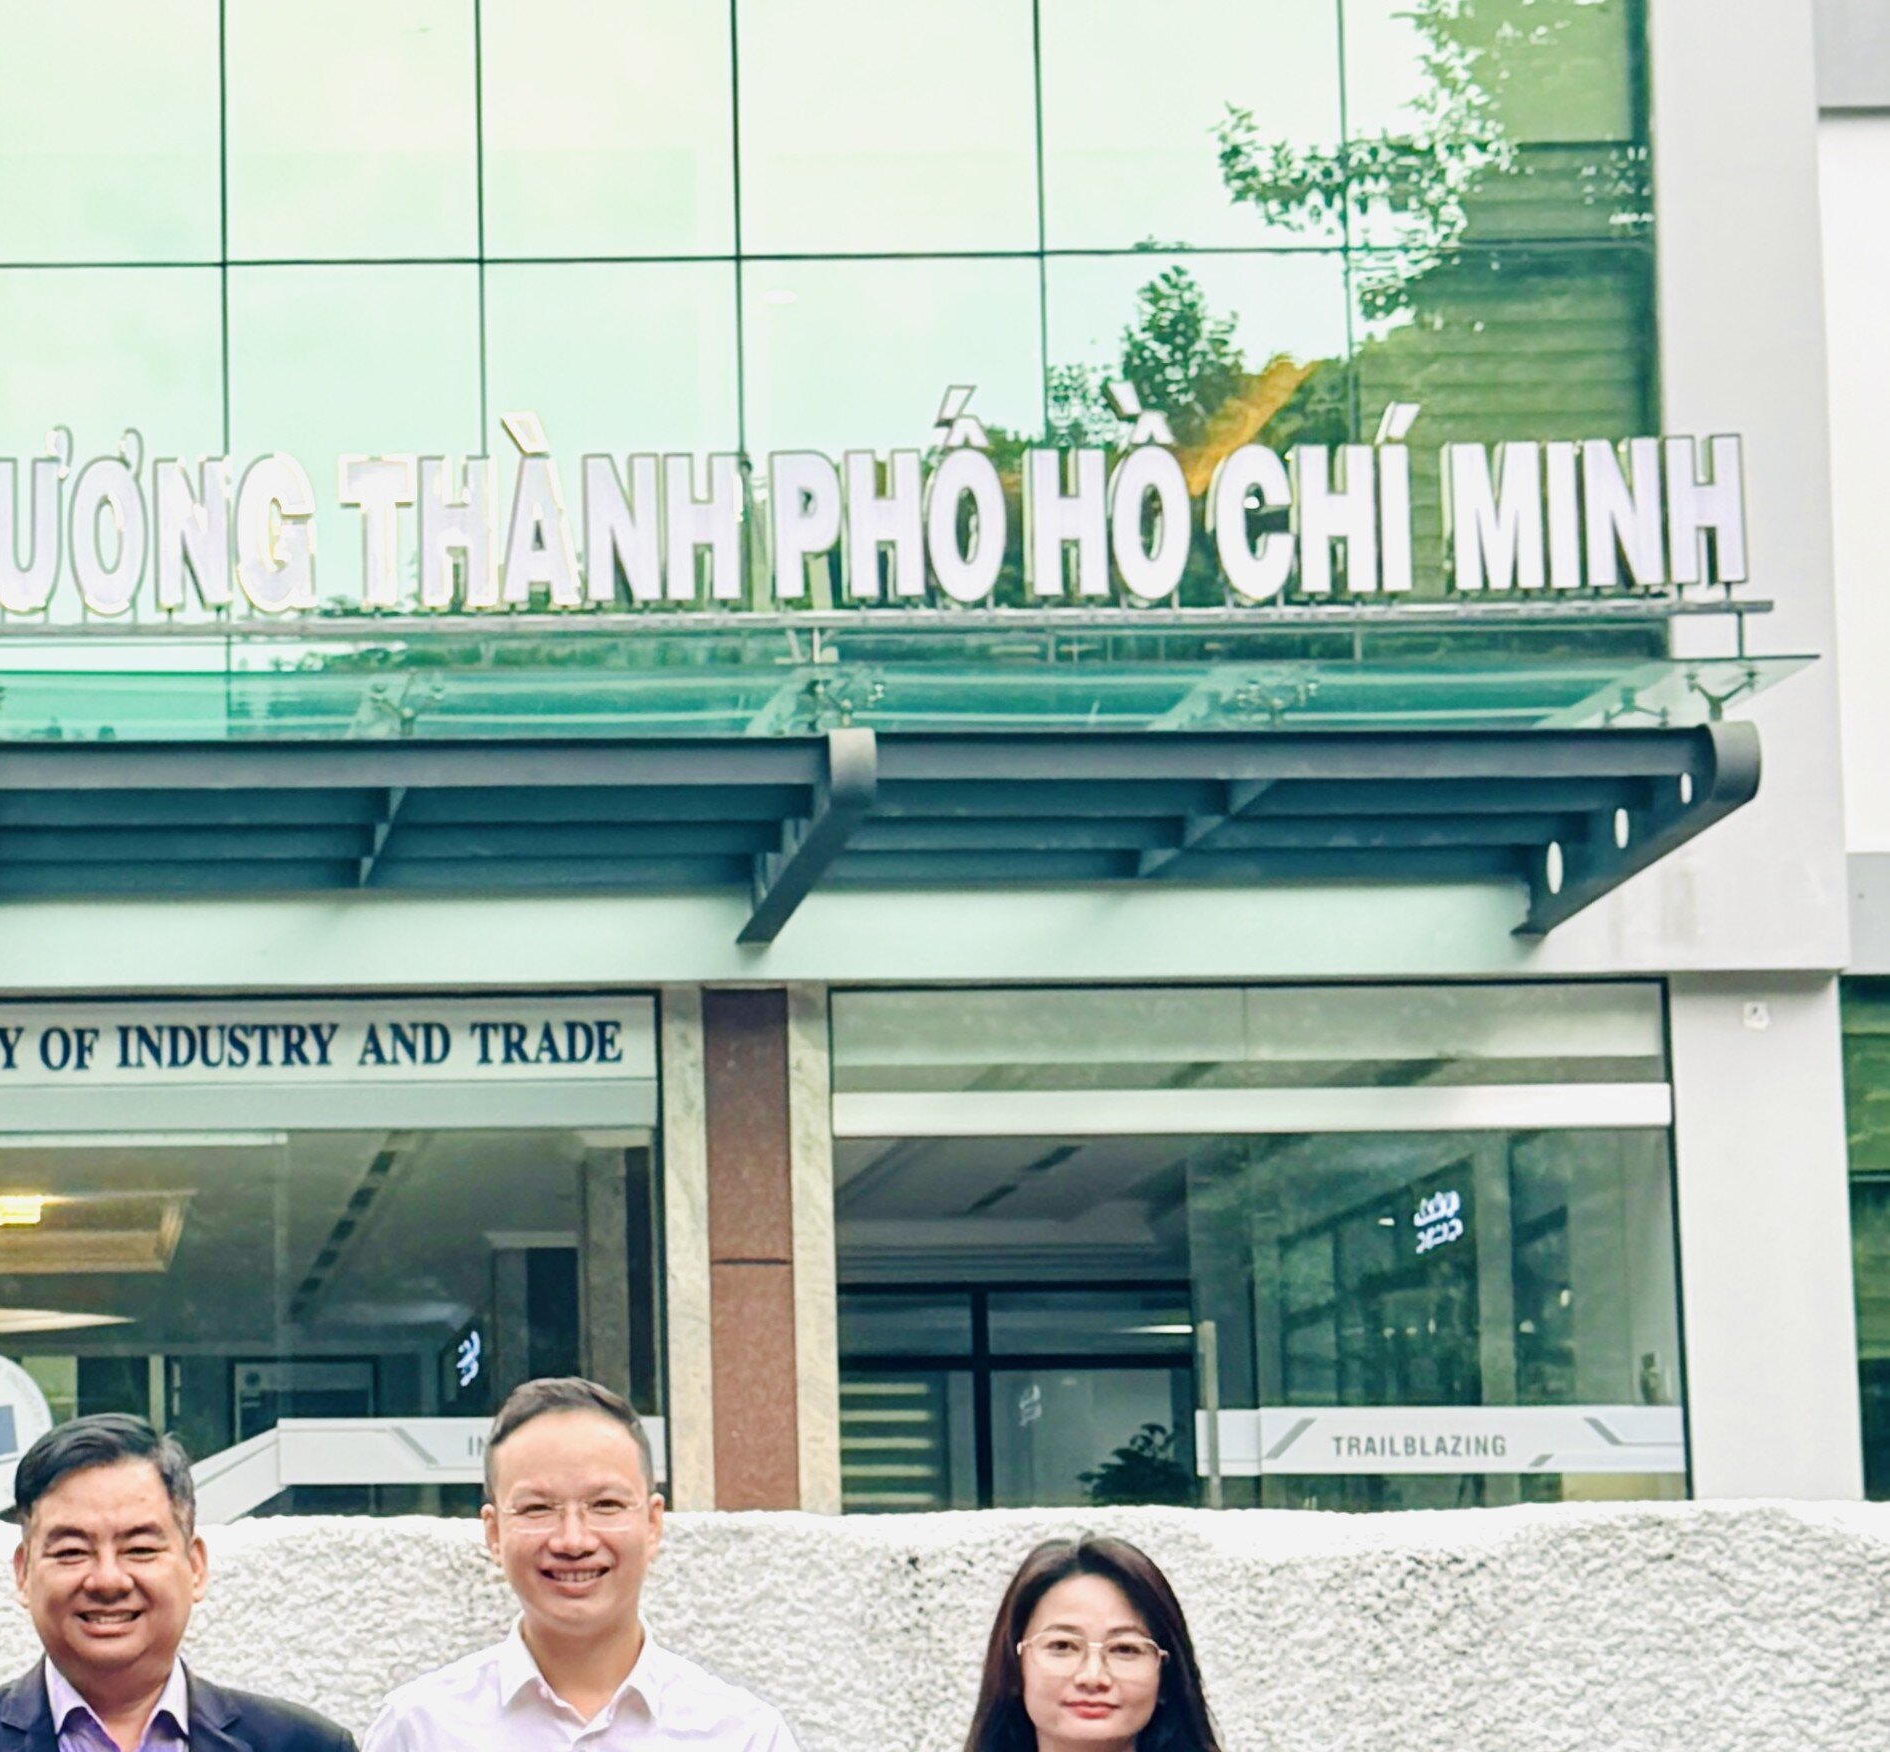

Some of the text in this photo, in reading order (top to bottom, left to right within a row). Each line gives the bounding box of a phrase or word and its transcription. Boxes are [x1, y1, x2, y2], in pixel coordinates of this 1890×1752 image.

[339, 410, 742, 609] THÀNH
[768, 384, 1007, 602] PHỐ
[1024, 382, 1192, 600] HỒ
[1208, 401, 1421, 597] CHÍ
[1442, 432, 1749, 592] MINH
[39, 1027, 100, 1070] OF
[116, 1022, 339, 1070] INDUSTRY
[358, 1021, 452, 1067] AND
[470, 1020, 624, 1066] TRADE
[1332, 1434, 1508, 1458] TRAILBLAZING
